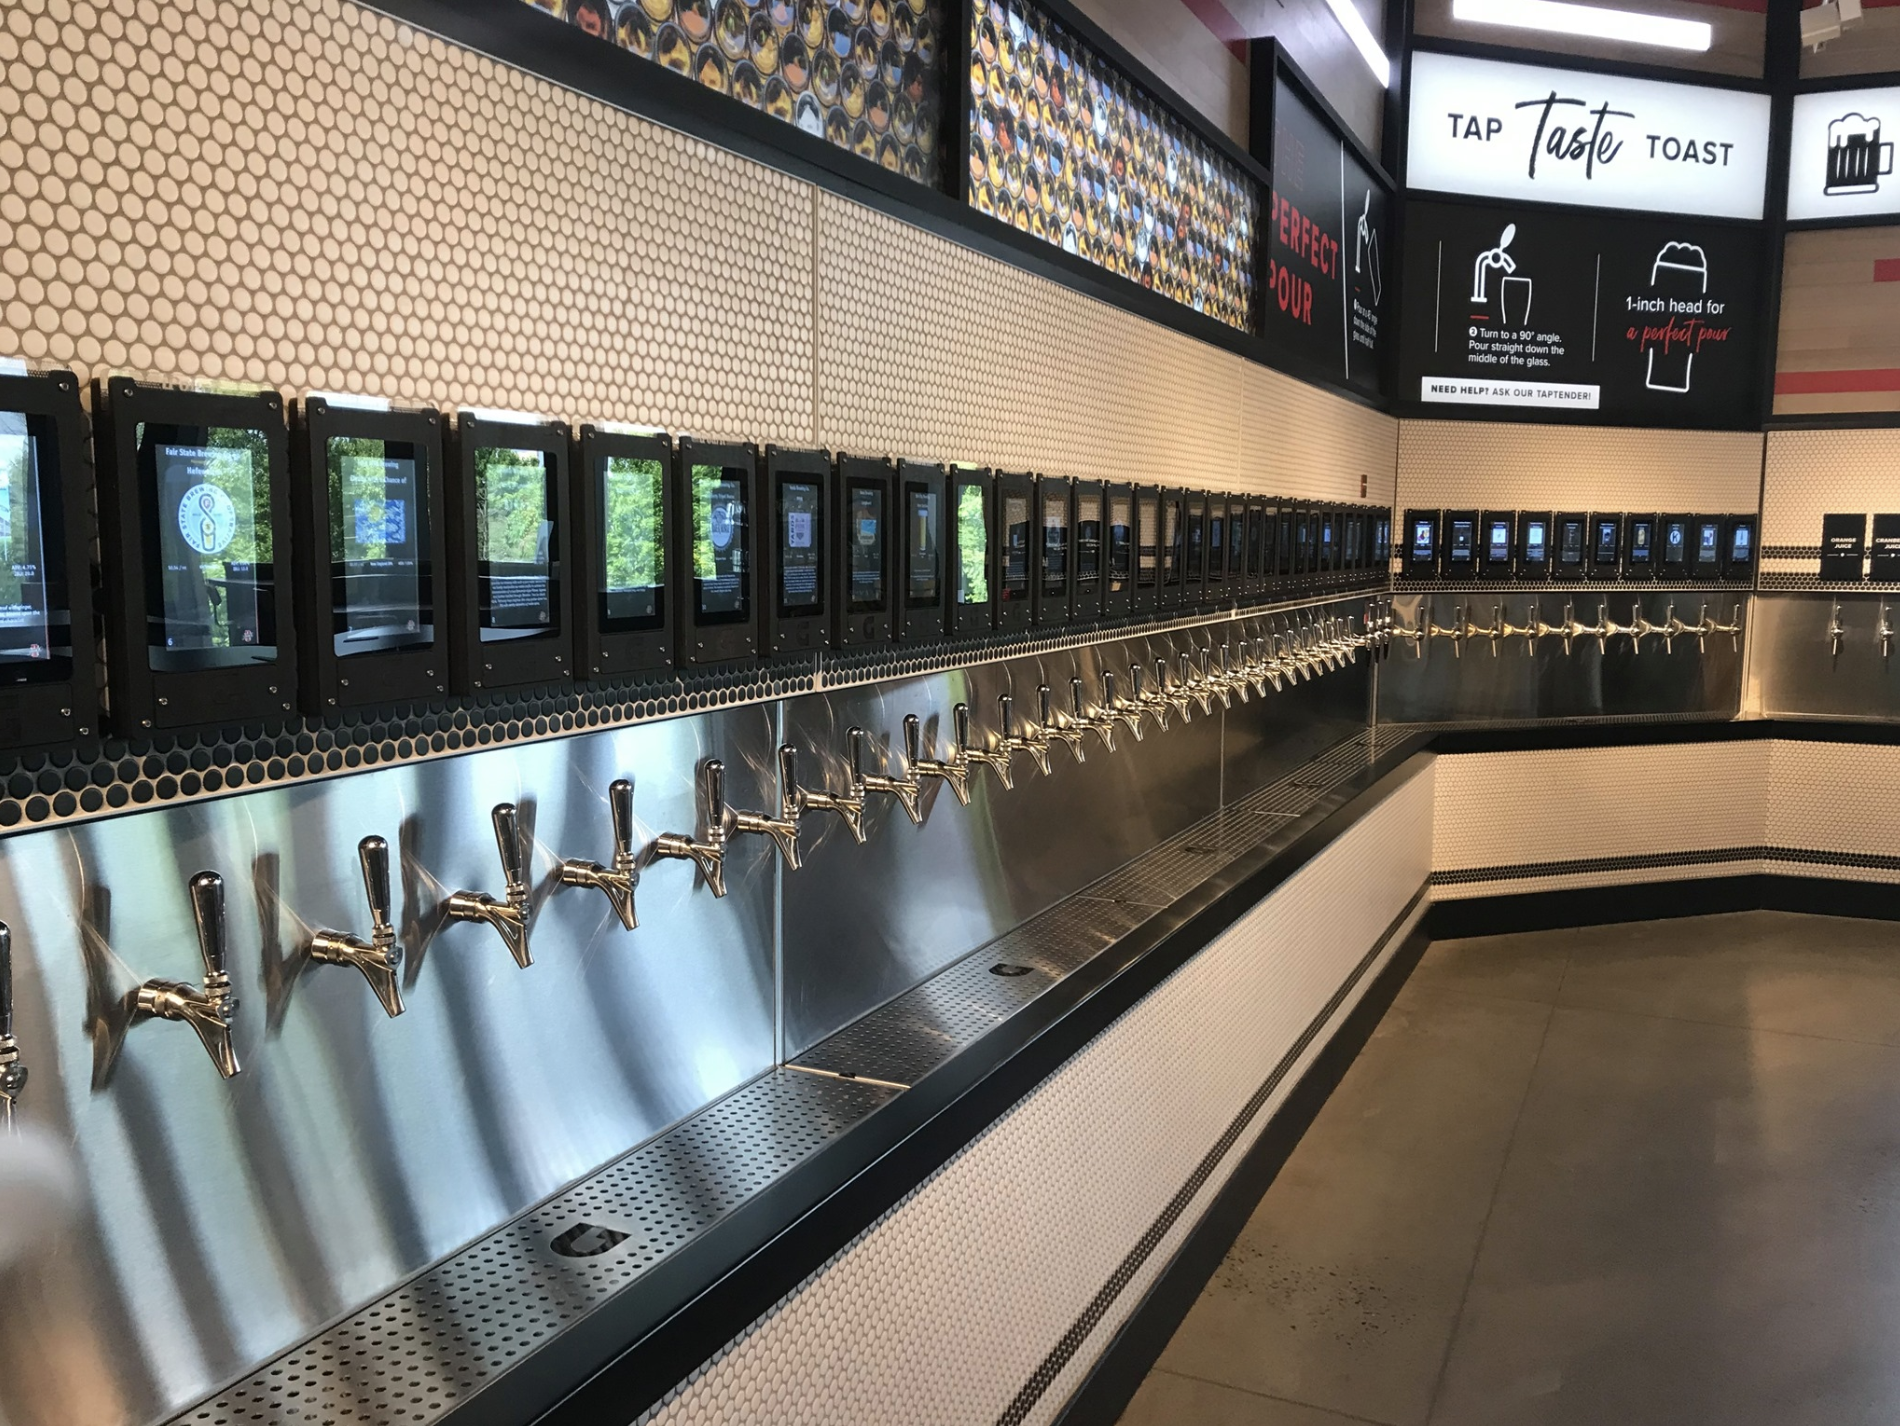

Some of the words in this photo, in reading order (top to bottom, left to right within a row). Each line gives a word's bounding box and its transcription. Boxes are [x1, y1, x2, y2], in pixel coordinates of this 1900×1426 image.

[1447, 113, 1503, 142] TAP
[1514, 90, 1636, 180] Taste
[1646, 134, 1734, 166] TOAST
[1625, 296, 1665, 312] 1-inch
[1669, 298, 1702, 314] head
[1706, 299, 1725, 314] for
[1480, 328, 1498, 338] Turn
[1500, 330, 1510, 340] to
[1536, 332, 1562, 344] angle.
[1626, 326, 1639, 341] a
[1640, 315, 1705, 355] perfect
[1695, 326, 1732, 353] pour
[1468, 340, 1489, 350] Pour
[1491, 341, 1524, 353] straight
[1525, 344, 1549, 354] down
[1550, 345, 1564, 355] the
[1468, 353, 1497, 364] middle
[1500, 355, 1509, 364] of
[1510, 356, 1525, 365] the
[1526, 356, 1551, 368] glass.
[1431, 384, 1457, 394] NEED
[1460, 386, 1489, 395] HELP?
[1492, 388, 1510, 396] ASK
[1513, 388, 1533, 398] OUR
[1537, 389, 1592, 400] TAPTENDER!
[165, 447, 178, 456] Fair
[179, 448, 196, 457] State
[168, 638, 173, 646] 6
